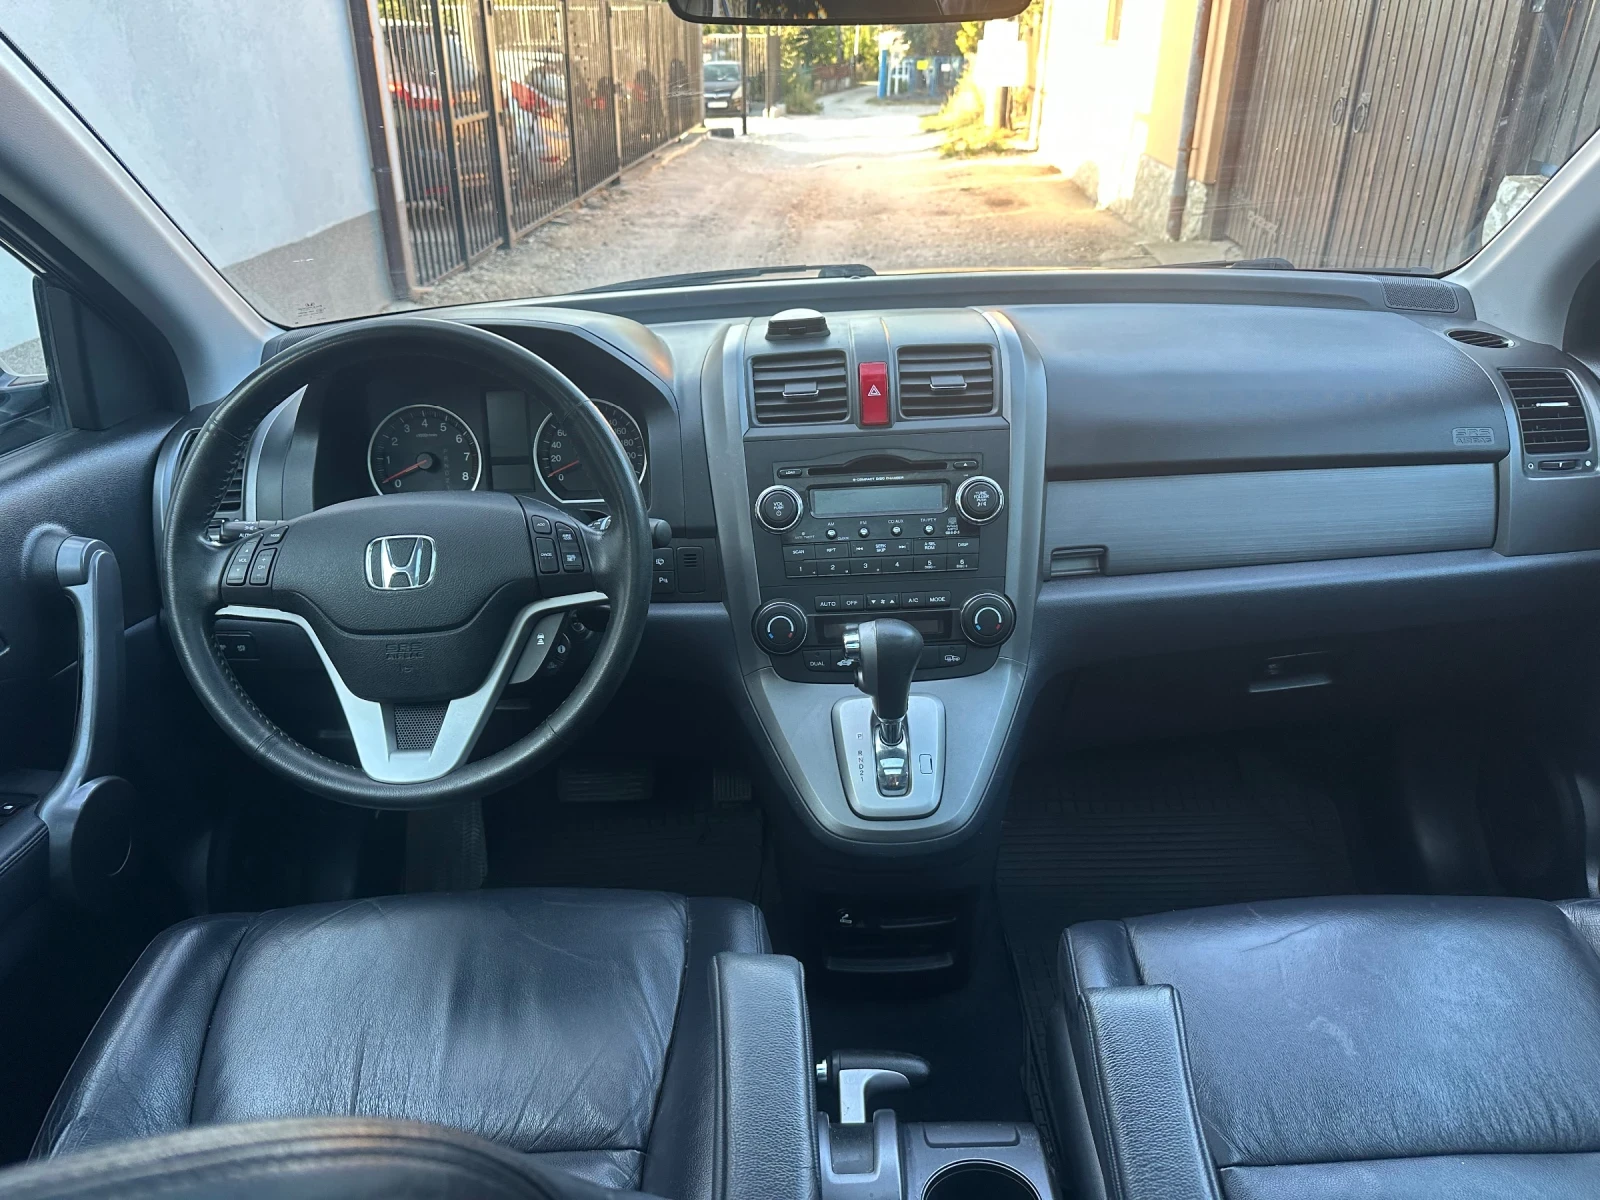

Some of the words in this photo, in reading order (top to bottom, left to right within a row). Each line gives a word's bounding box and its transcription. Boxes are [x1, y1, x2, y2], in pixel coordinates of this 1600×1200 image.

[422, 418, 428, 427] 4
[440, 423, 446, 431] 5
[404, 424, 410, 433] 3
[392, 437, 398, 446] 2
[456, 434, 462, 443] 6
[386, 456, 390, 464] 1
[464, 452, 470, 461] 7
[462, 472, 469, 480] 8
[395, 479, 402, 488] 0
